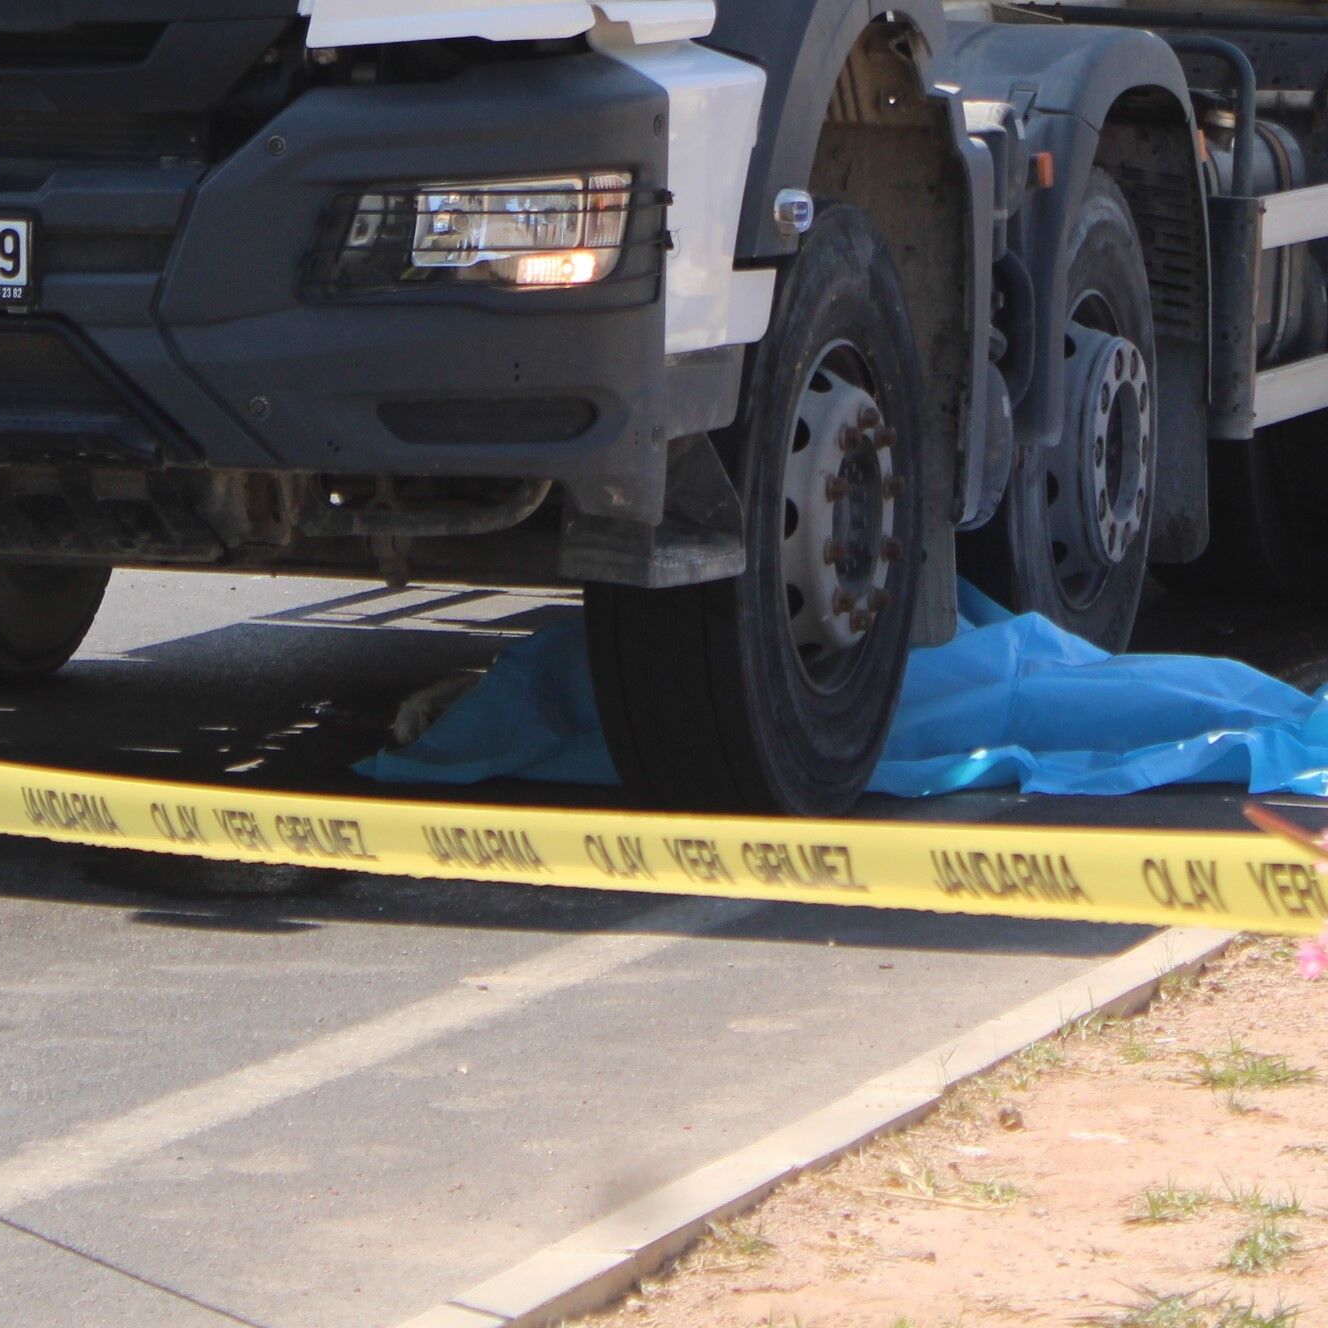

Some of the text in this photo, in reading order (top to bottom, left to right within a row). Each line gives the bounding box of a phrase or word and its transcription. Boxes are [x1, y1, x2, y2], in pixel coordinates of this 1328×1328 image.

[2, 287, 12, 299] 23
[21, 785, 127, 837] JANDARMA
[150, 802, 211, 848] OLAY
[421, 824, 555, 875] JANDARMA
[582, 834, 659, 882] OLAY
[929, 849, 1095, 906] JANDARMA
[1141, 857, 1231, 915] OLAY
